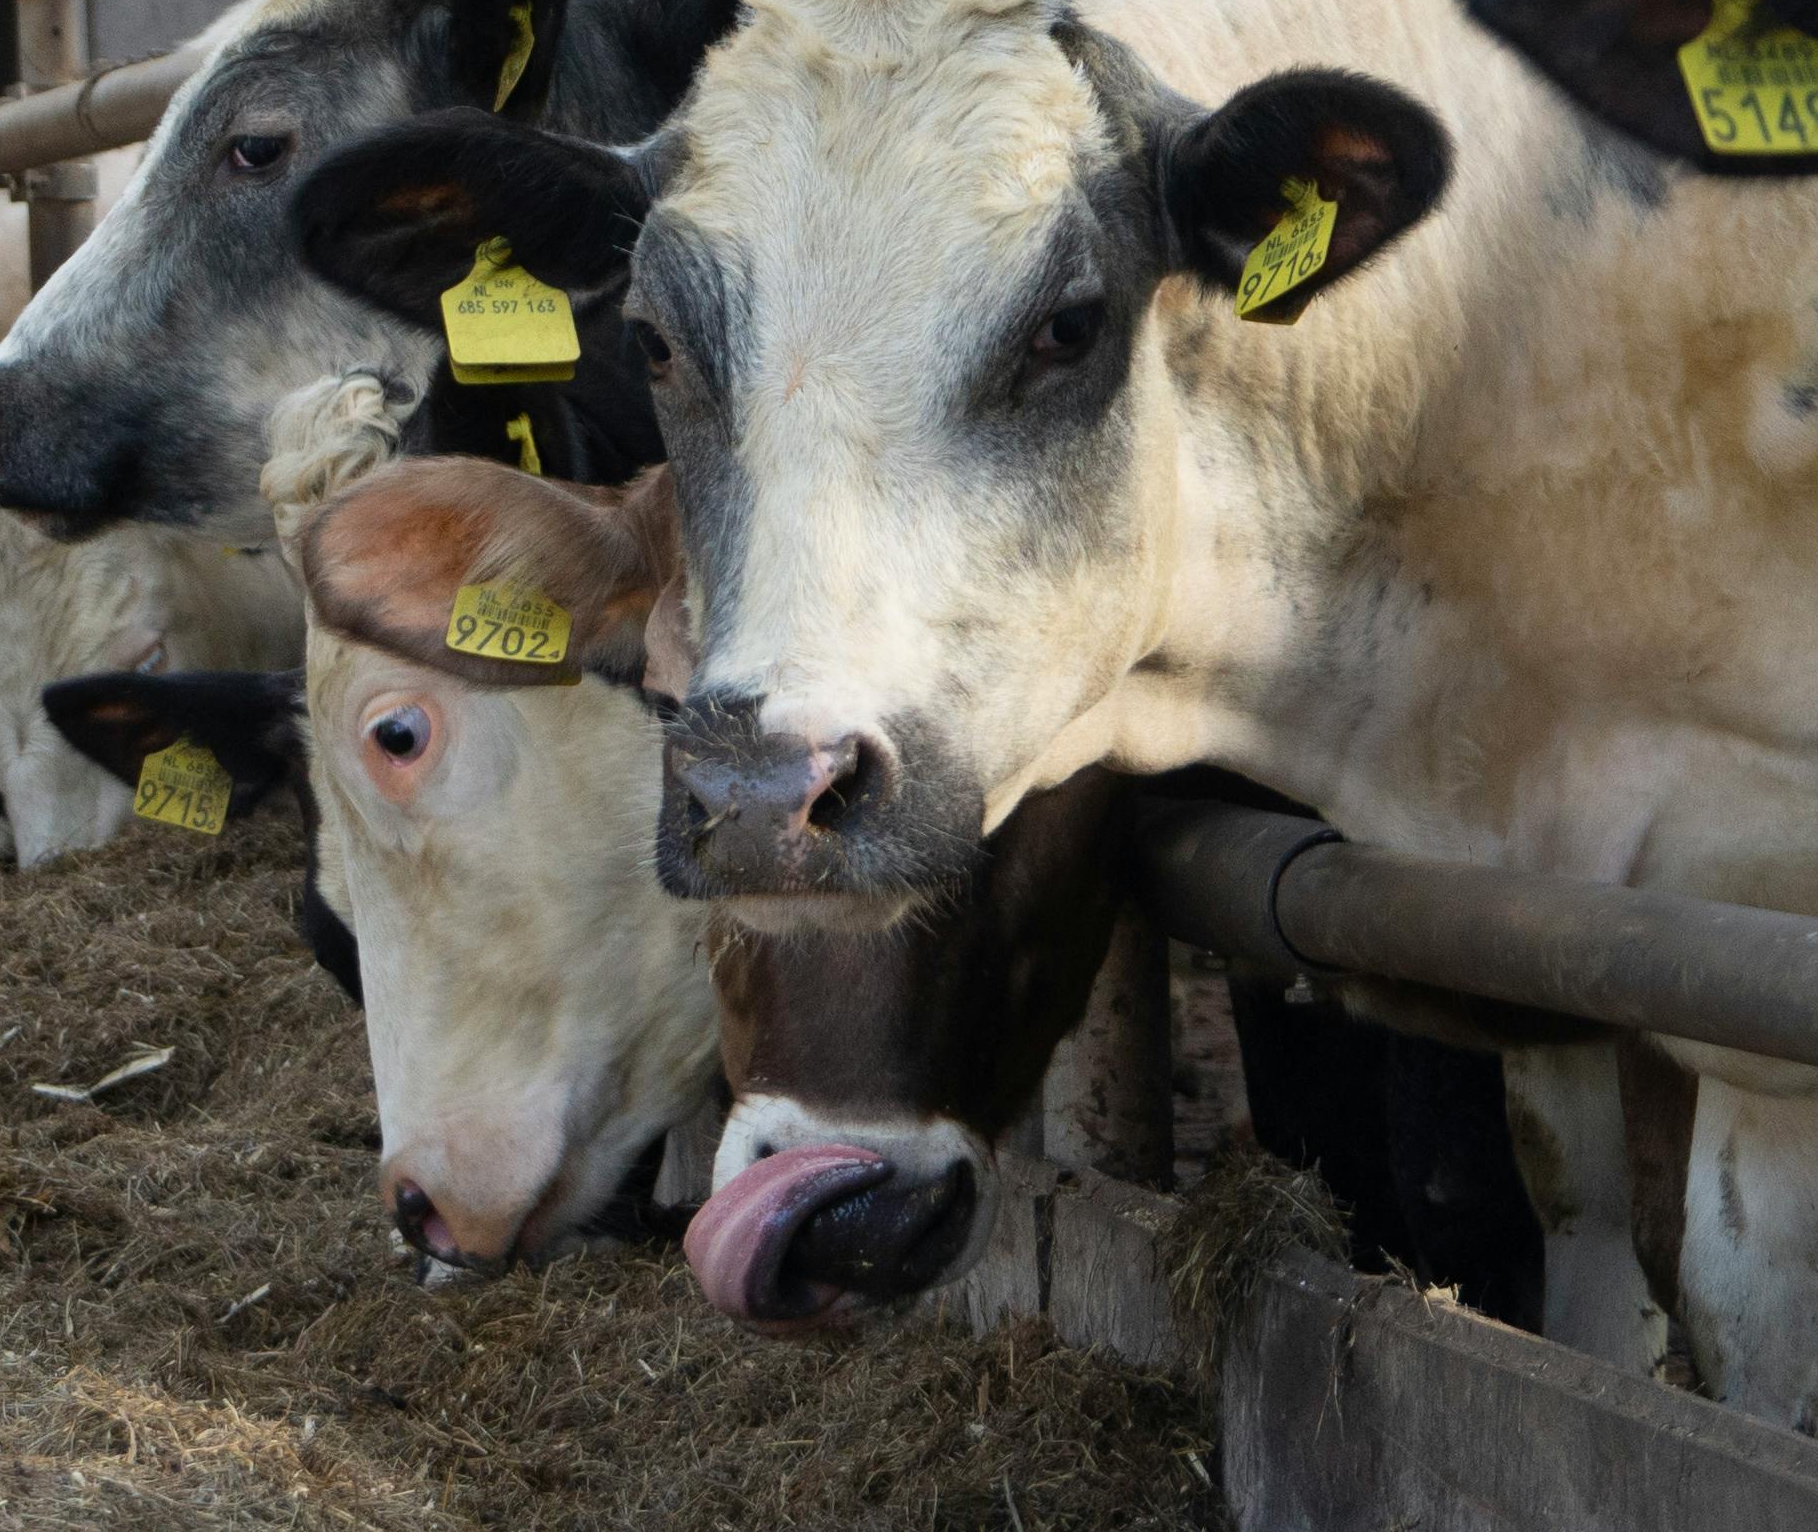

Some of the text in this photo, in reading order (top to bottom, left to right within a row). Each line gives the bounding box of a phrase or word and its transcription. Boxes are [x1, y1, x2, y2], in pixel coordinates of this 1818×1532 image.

[1265, 206, 1325, 252] NL 6855
[473, 284, 492, 298] NL
[1240, 239, 1317, 310] 9716
[457, 299, 556, 315] 685 597 163
[479, 588, 555, 617] NL 6855
[454, 615, 550, 658] 9702
[137, 779, 213, 827] 9715
